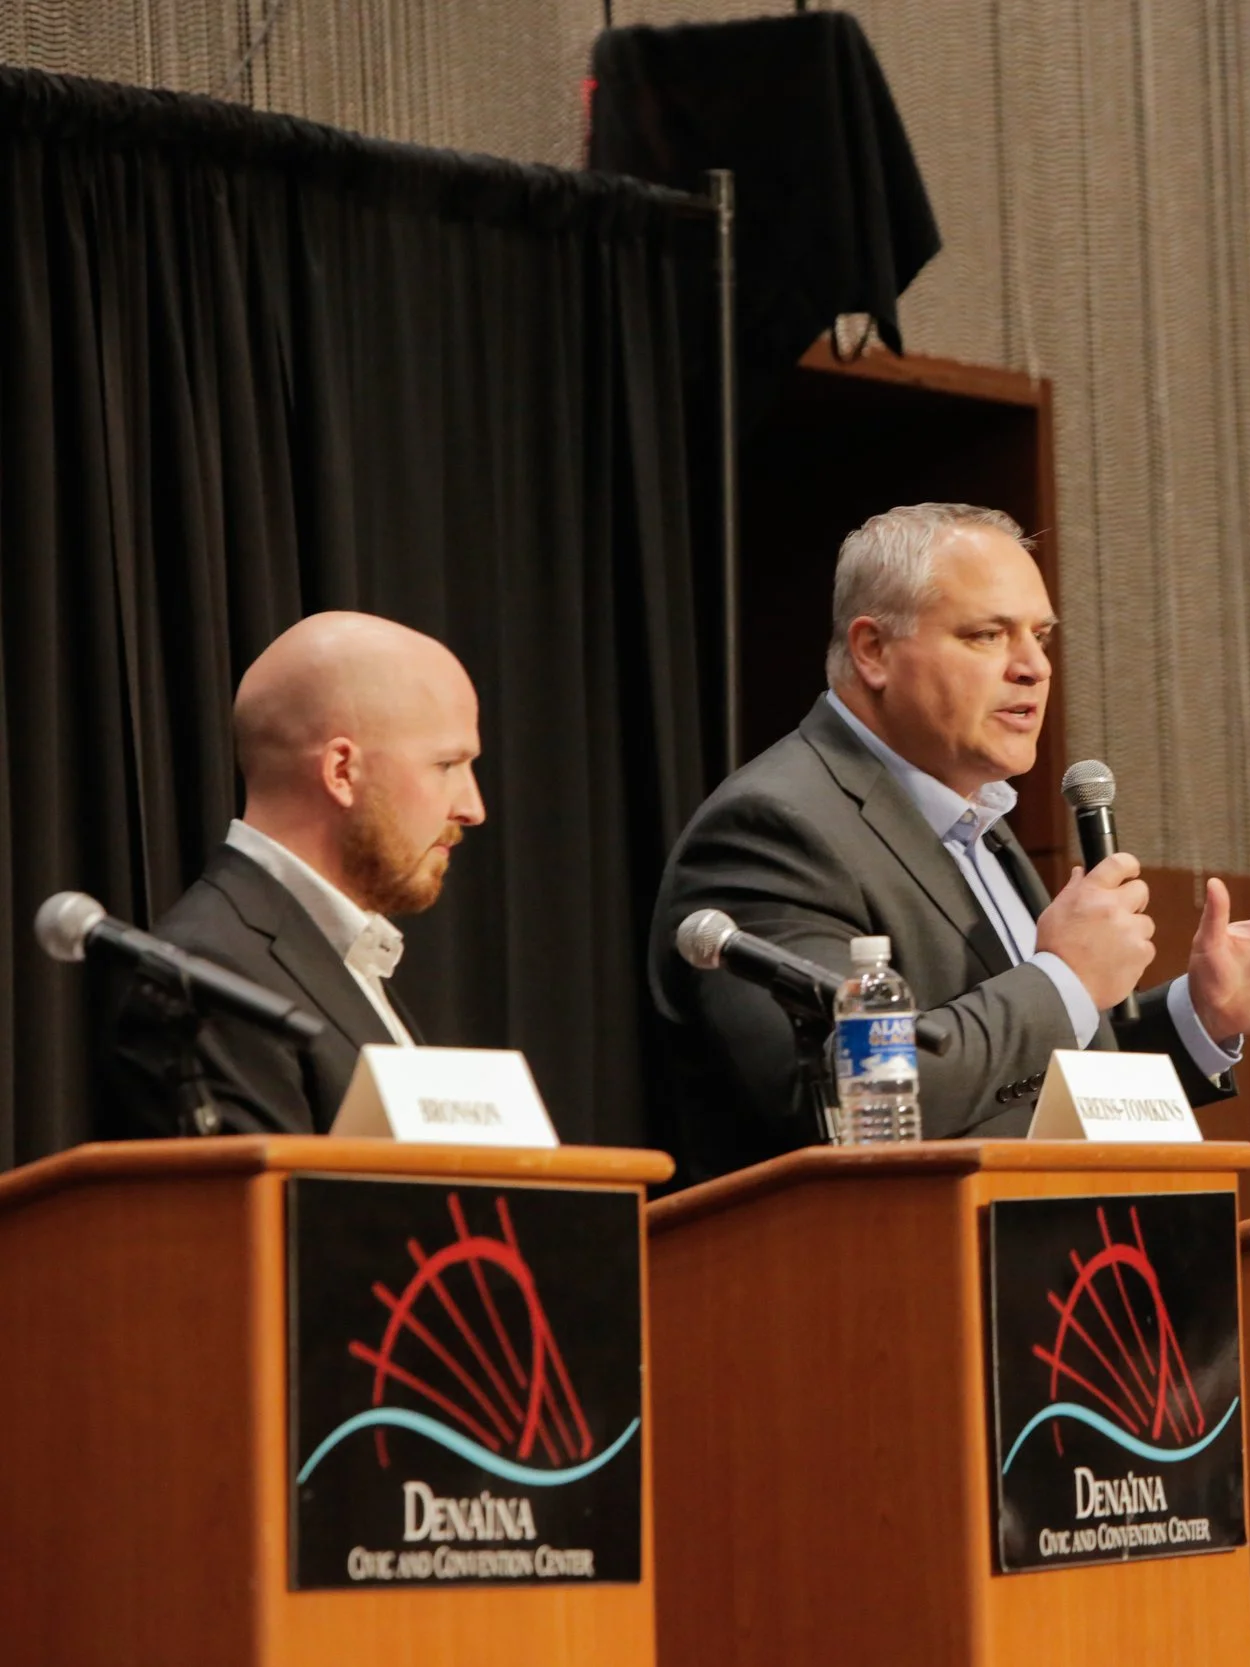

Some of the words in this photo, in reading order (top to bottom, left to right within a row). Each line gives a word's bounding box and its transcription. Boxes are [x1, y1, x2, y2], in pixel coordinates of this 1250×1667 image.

[1039, 1528, 1071, 1557] CIVIC
[1073, 1529, 1097, 1553] AND
[1097, 1522, 1167, 1551] CONVENTION
[1168, 1516, 1211, 1544] CENTER
[348, 1546, 395, 1580] CIVIC
[396, 1550, 432, 1579] AND
[433, 1545, 534, 1579] CONVENTION
[535, 1544, 595, 1577] CENTER
